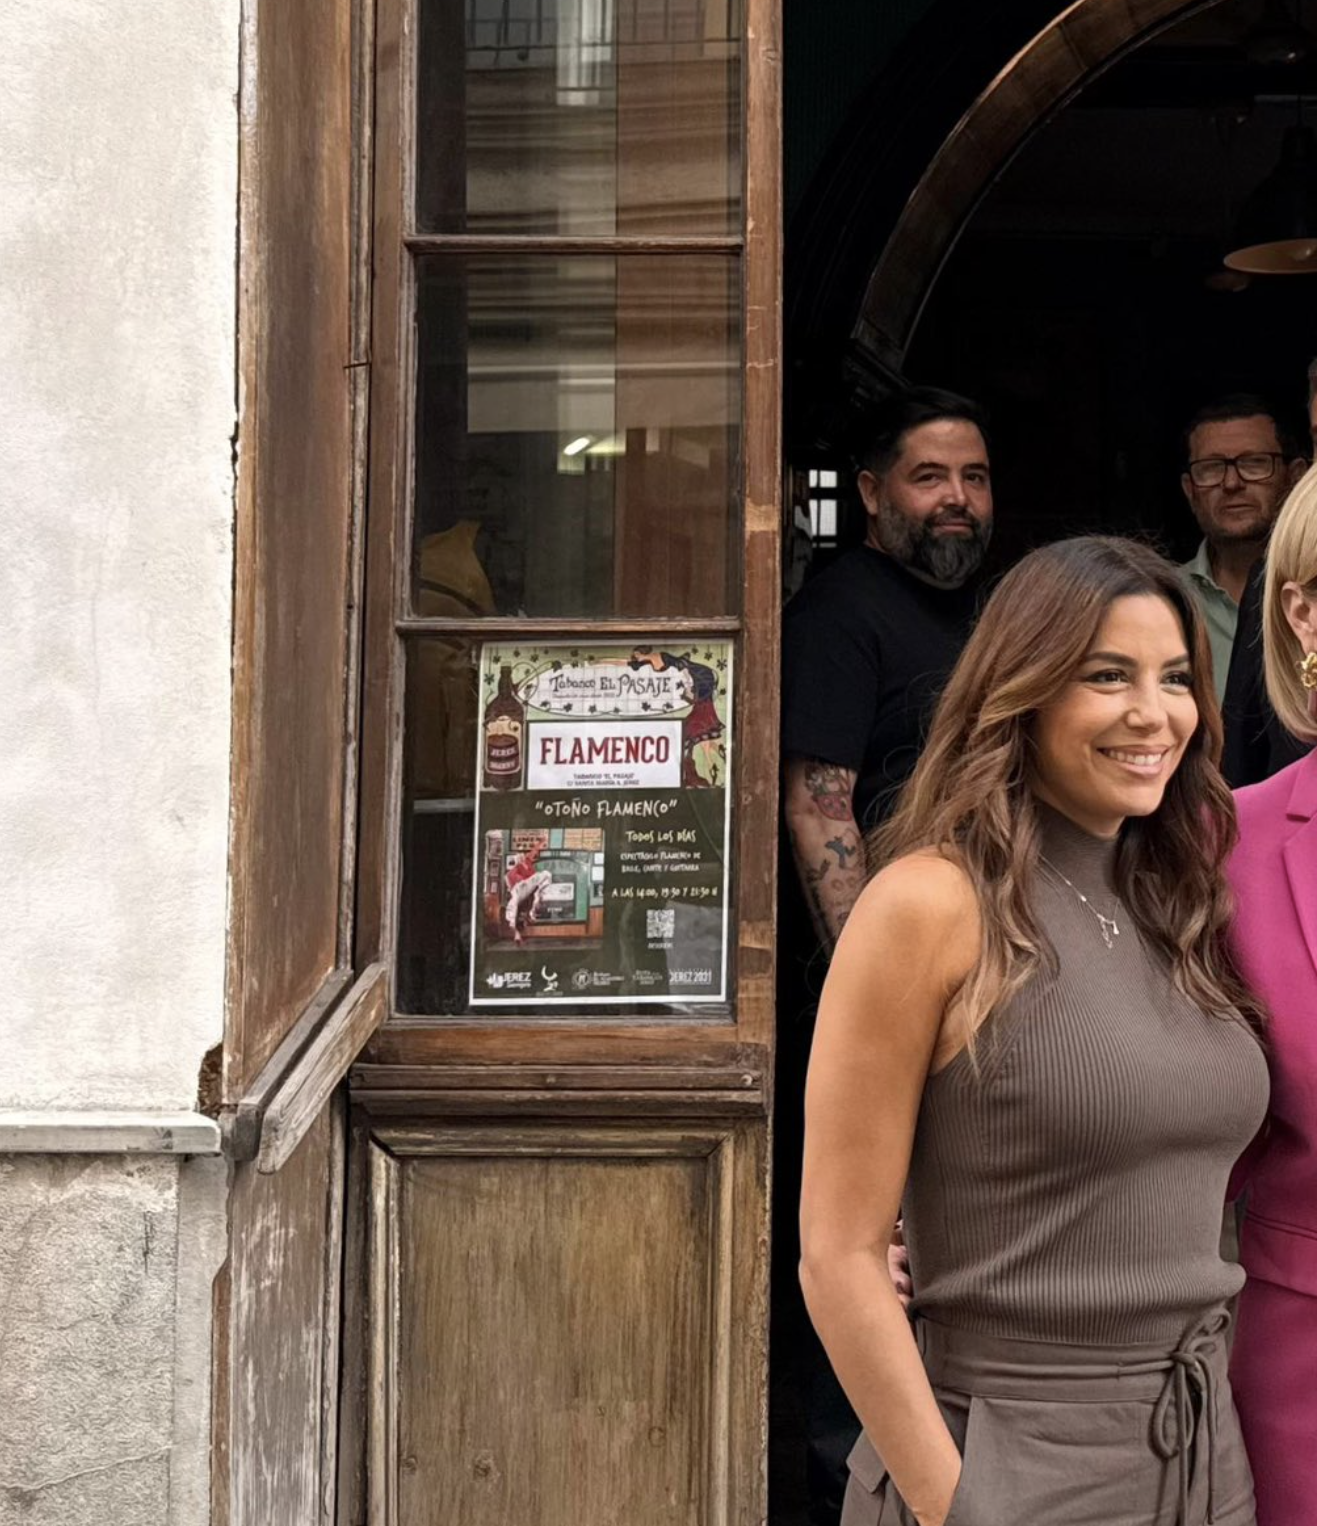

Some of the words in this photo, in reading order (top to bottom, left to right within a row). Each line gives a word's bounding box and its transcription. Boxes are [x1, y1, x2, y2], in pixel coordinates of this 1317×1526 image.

[550, 674, 595, 692] Tabanco
[599, 676, 616, 690] EL
[616, 673, 671, 698] PASAJE
[540, 735, 670, 765] FLAMENCO
[625, 830, 655, 843] TODOS
[657, 829, 674, 842] LOS
[677, 828, 697, 842] DÍAS
[611, 888, 618, 898] A
[620, 887, 634, 898] LAS
[503, 972, 532, 982] JEREZ
